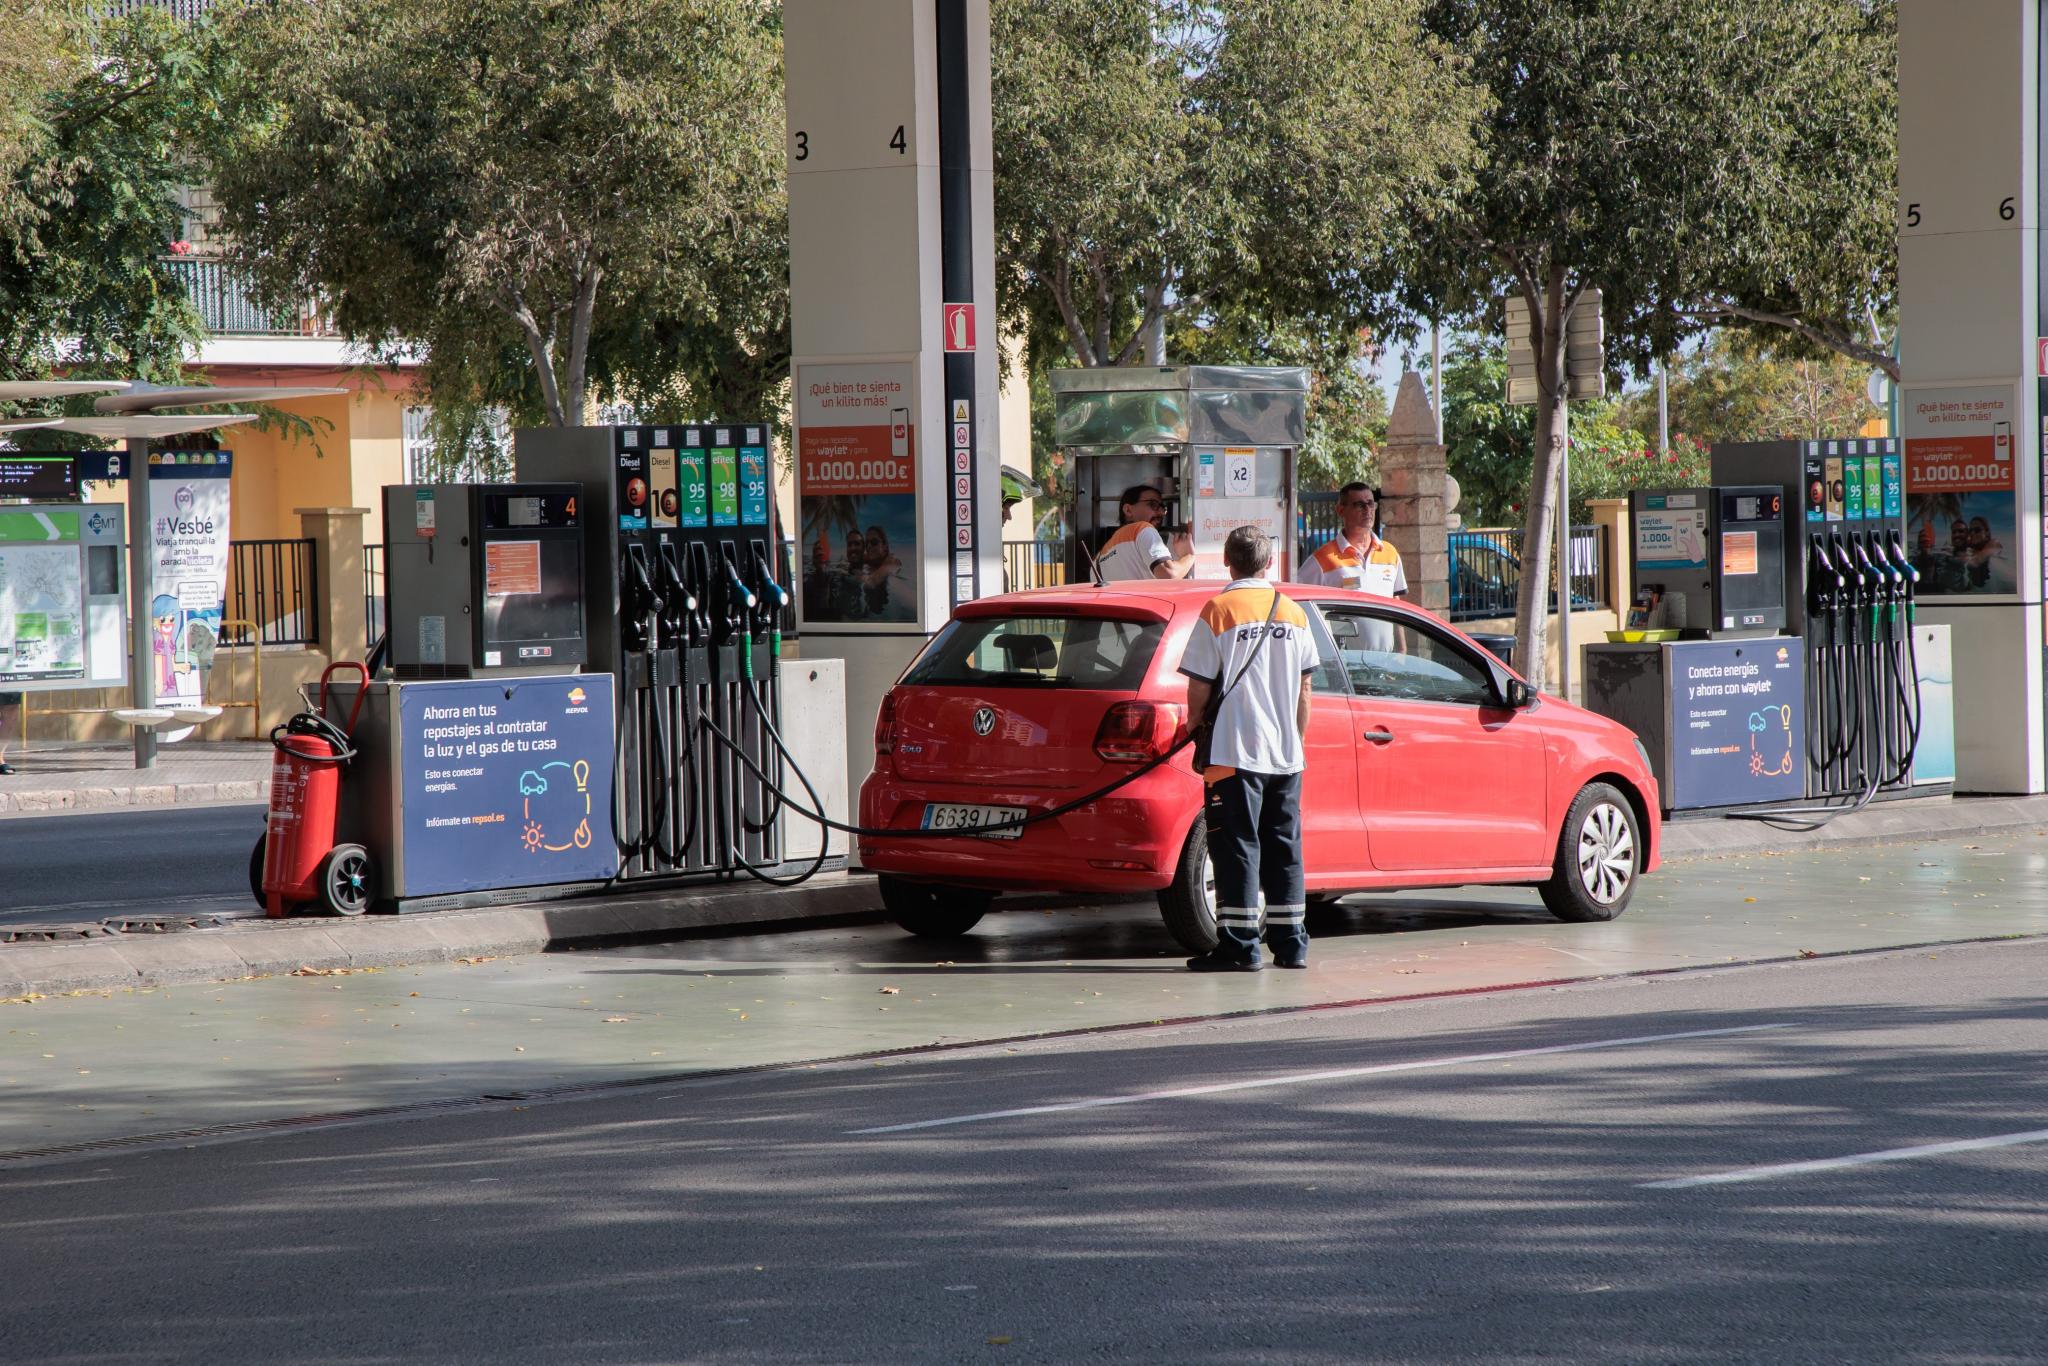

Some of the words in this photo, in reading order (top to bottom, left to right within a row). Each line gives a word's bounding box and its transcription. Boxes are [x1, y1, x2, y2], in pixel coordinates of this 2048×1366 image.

[795, 131, 809, 160] 3
[889, 125, 907, 155] 4
[1907, 204, 1921, 227] 5
[1999, 197, 2015, 221] 6
[810, 382, 830, 396] ¡Qué
[833, 382, 853, 394] bien
[857, 382, 867, 393] te
[870, 381, 901, 392] sienta
[822, 398, 834, 408] un
[836, 396, 860, 407] kilito
[863, 395, 888, 406] más!
[1917, 402, 1937, 414] ¡Qué
[1940, 401, 1960, 412] bien
[1962, 401, 1972, 410] te
[1975, 400, 2004, 410] sienta
[1929, 414, 1940, 423] un
[1943, 412, 1966, 423] kilito
[1968, 411, 1992, 422] más!
[620, 457, 640, 467] Diesel
[651, 457, 671, 466] Diesel
[682, 456, 704, 465] efitec
[712, 455, 735, 464] efitec
[807, 460, 897, 481] 1.000.000
[898, 465, 908, 479] €
[1233, 467, 1247, 480] x2
[1913, 464, 1999, 482] 1.000.000
[2001, 467, 2010, 479] €
[689, 483, 705, 499] 95
[720, 482, 736, 498] 98
[749, 481, 765, 497] 95
[1850, 485, 1861, 497] 95
[1869, 484, 1880, 496] 98
[1889, 482, 1899, 495] 95
[566, 497, 577, 516] 4
[1772, 496, 1780, 512] 6
[156, 516, 213, 535] #Vesbé
[1222, 517, 1240, 527] bien
[156, 537, 177, 547] Viatja
[174, 547, 191, 556] amb
[192, 547, 199, 555] la
[160, 557, 186, 567] parada
[1688, 665, 1722, 678] Conecta
[1724, 661, 1759, 678] energías
[1689, 686, 1695, 700] y
[1697, 684, 1723, 697] ahorra
[1725, 684, 1739, 694] con
[1741, 680, 1771, 695] waylet
[424, 706, 460, 720] Ahorra
[462, 706, 476, 718] en
[479, 704, 497, 717] tus
[424, 723, 481, 741] repostajes
[484, 721, 495, 735] al
[497, 720, 548, 734] contratar
[424, 744, 434, 758] la
[437, 743, 454, 757] luz
[456, 745, 463, 759] y
[465, 741, 477, 755] el
[479, 743, 498, 757] gas
[501, 739, 515, 752] de
[517, 739, 529, 751] tu
[532, 739, 557, 751] casa
[425, 769, 441, 779] Esto
[442, 770, 451, 778] es
[452, 767, 484, 777] conectar
[425, 781, 458, 794] energías.
[426, 817, 461, 828] Infórmate
[472, 813, 505, 825] repsol.es
[935, 807, 980, 828] 6639
